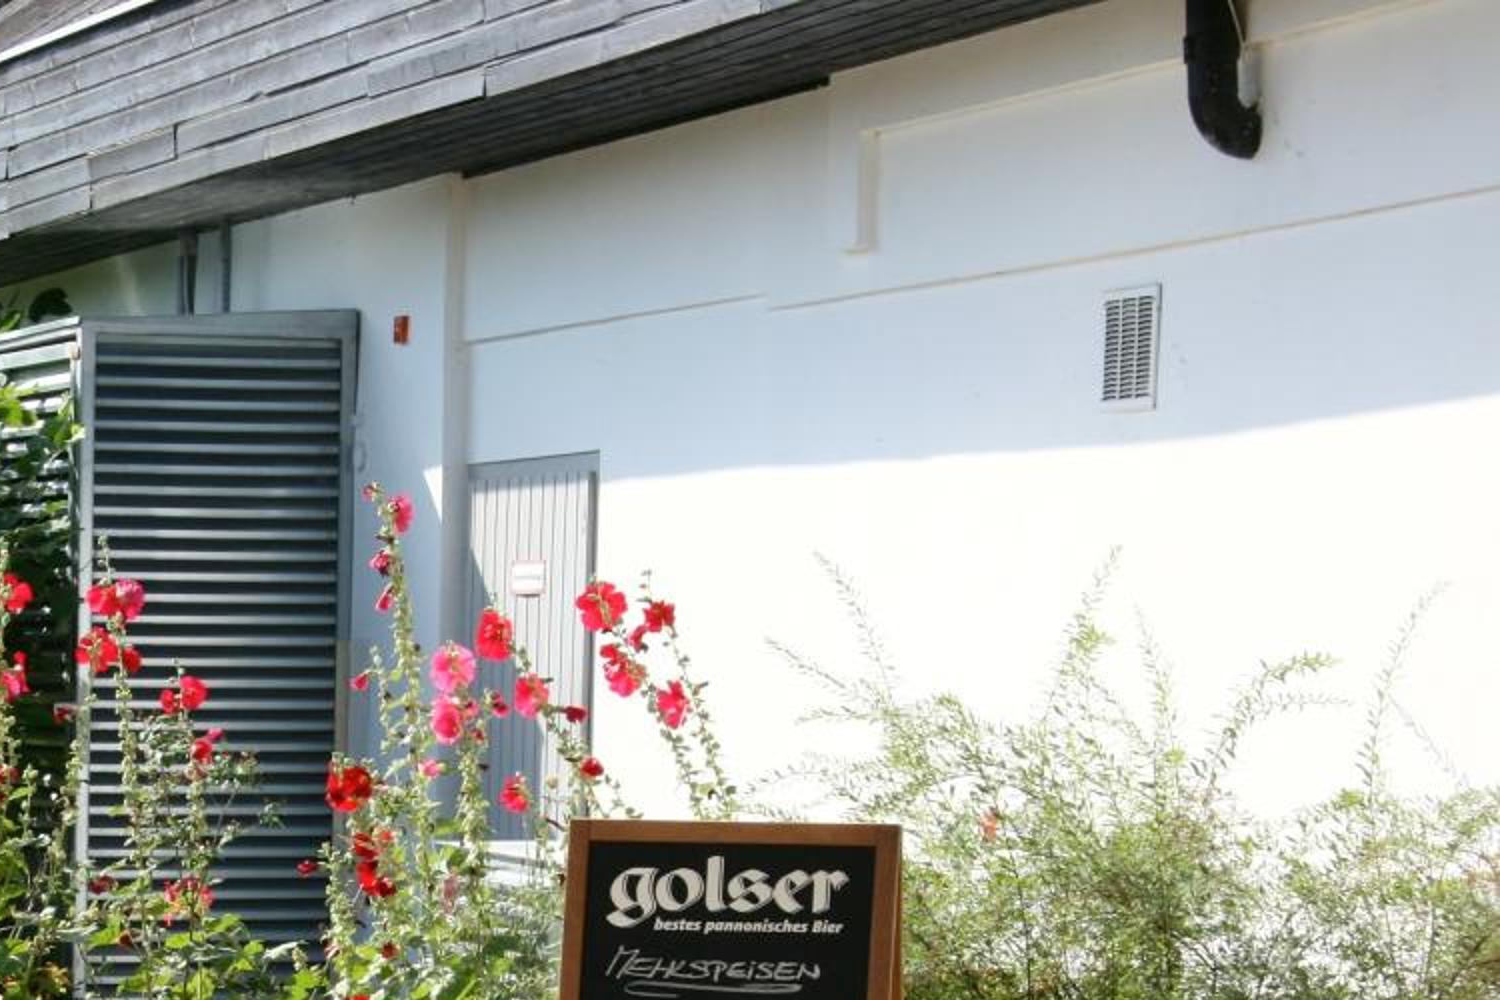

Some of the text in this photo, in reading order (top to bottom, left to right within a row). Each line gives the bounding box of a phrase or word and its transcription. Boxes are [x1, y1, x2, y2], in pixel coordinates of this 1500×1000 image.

[606, 855, 850, 928] golser
[653, 918, 844, 934] bestes pannonisches Bier
